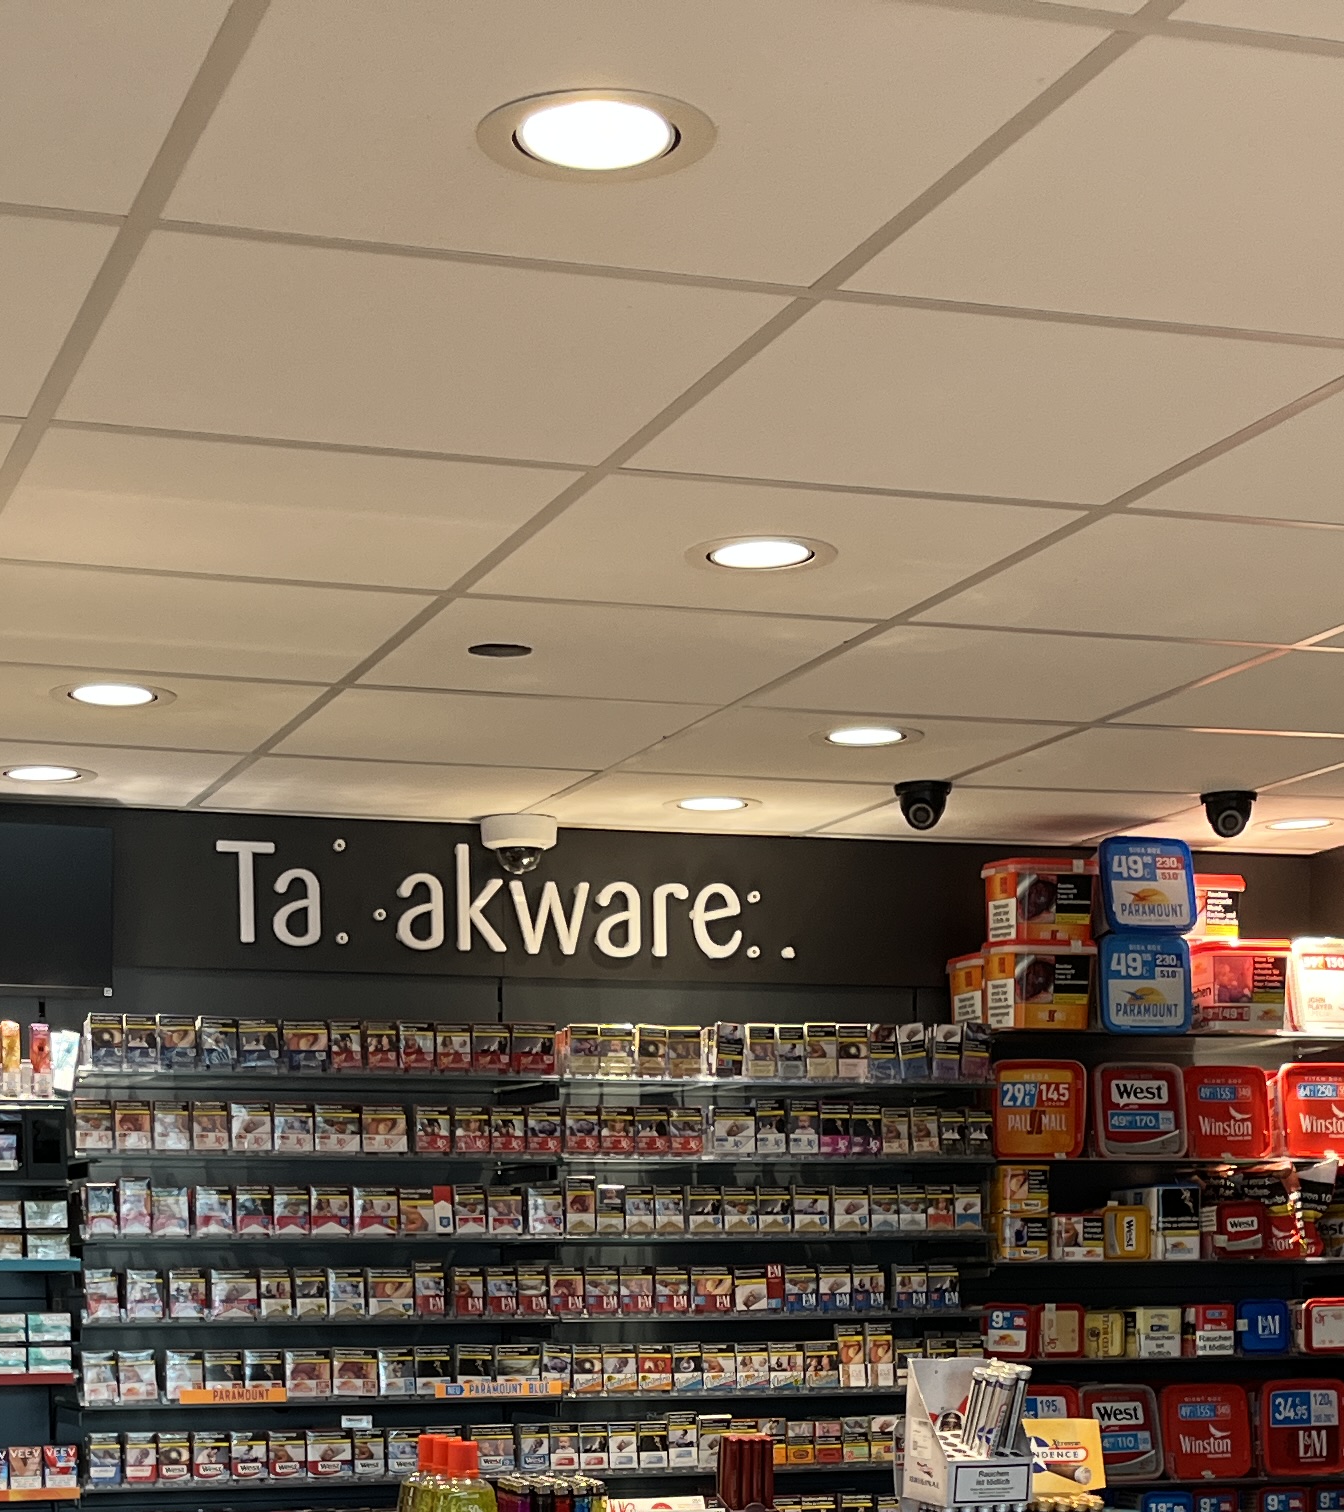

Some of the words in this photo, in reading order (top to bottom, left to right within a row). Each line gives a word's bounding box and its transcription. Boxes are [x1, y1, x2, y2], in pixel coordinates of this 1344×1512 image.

[1120, 903, 1183, 919] PARAMOUNT
[1115, 1003, 1178, 1018] PARAMOUNT
[1115, 1082, 1166, 1100] West
[1199, 1115, 1252, 1136] Winston
[212, 1389, 270, 1402] PARAMOUNT
[469, 1382, 523, 1395] PARAMOUNT
[1096, 1405, 1140, 1422] West
[1180, 1434, 1231, 1454] Winston
[978, 1470, 1009, 1478] Rauchen
